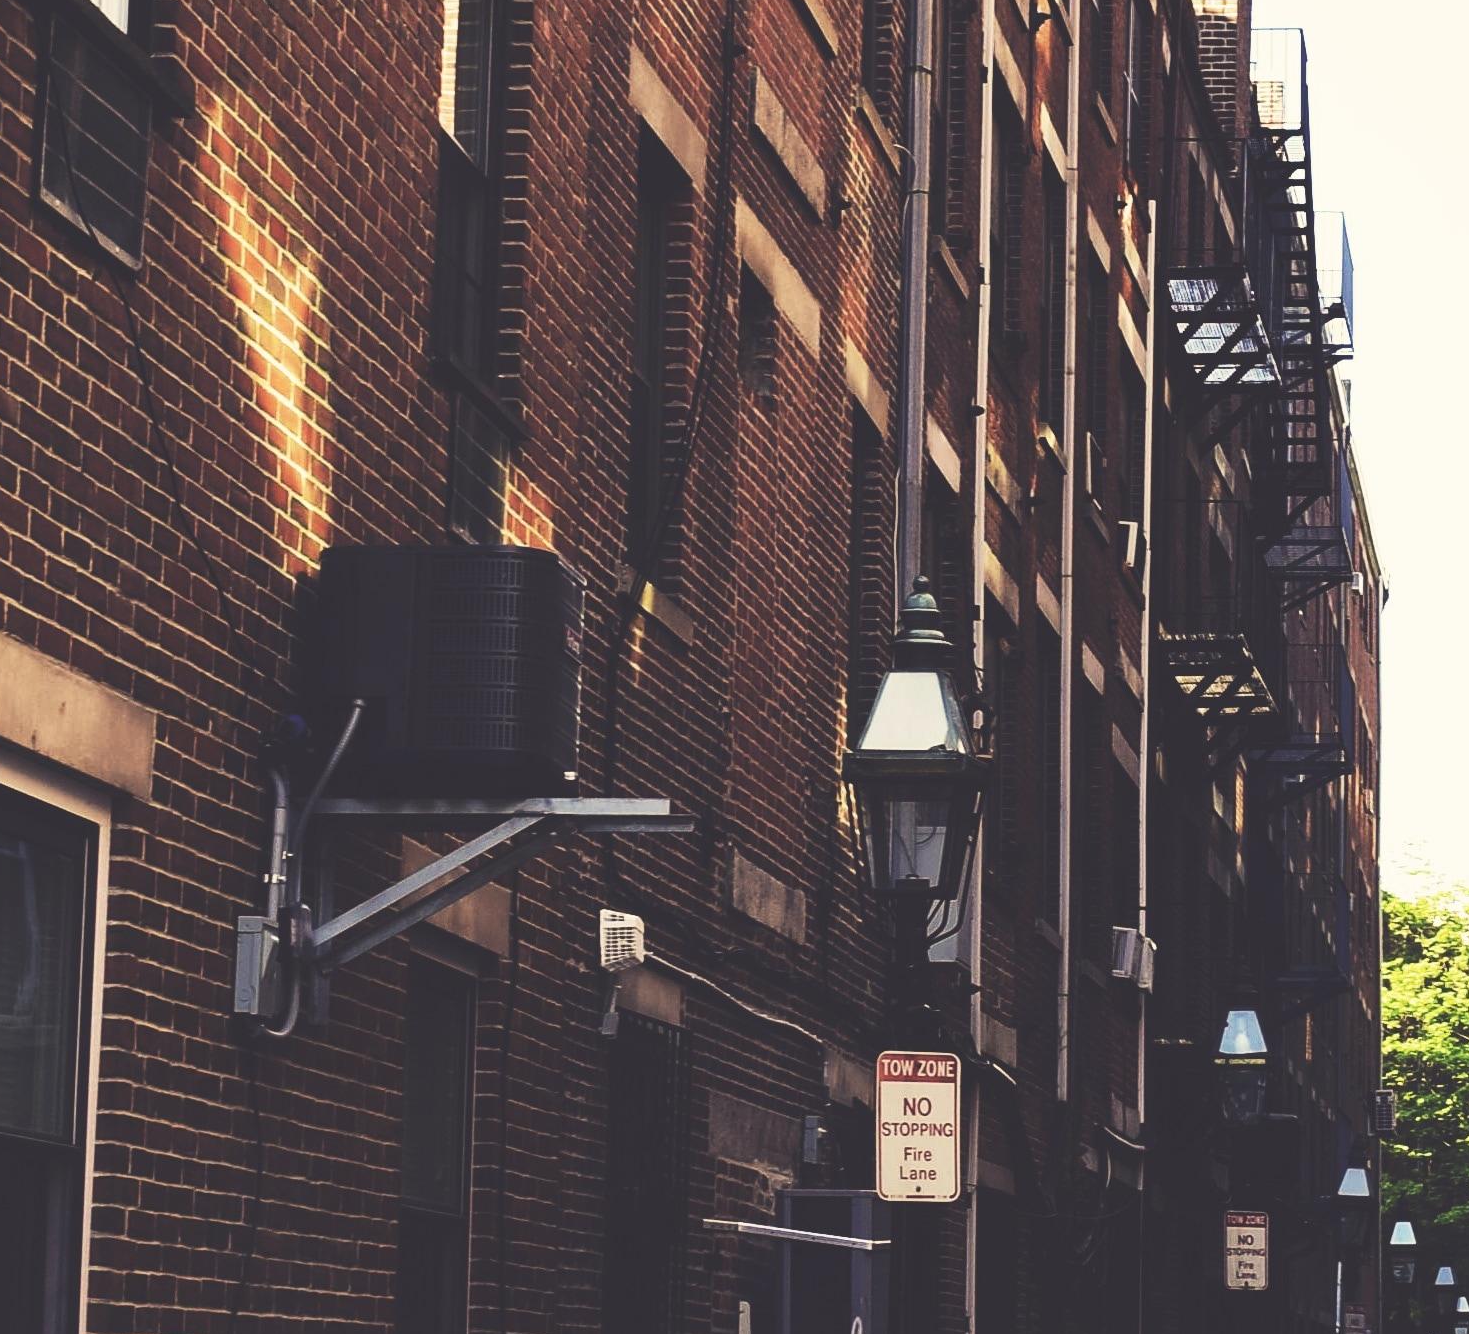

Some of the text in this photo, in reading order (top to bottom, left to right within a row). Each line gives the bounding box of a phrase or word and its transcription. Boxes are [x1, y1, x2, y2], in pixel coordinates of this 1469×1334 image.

[881, 1059, 955, 1078] TOW ZONE
[903, 1097, 932, 1117] NO
[881, 1122, 954, 1137] STOPPING
[904, 1147, 933, 1162] Fire
[899, 1166, 937, 1181] Lane
[1237, 1234, 1254, 1245] NO
[1226, 1248, 1265, 1256] STOPPING
[1238, 1261, 1254, 1269] Fire
[1235, 1271, 1257, 1279] Lane
